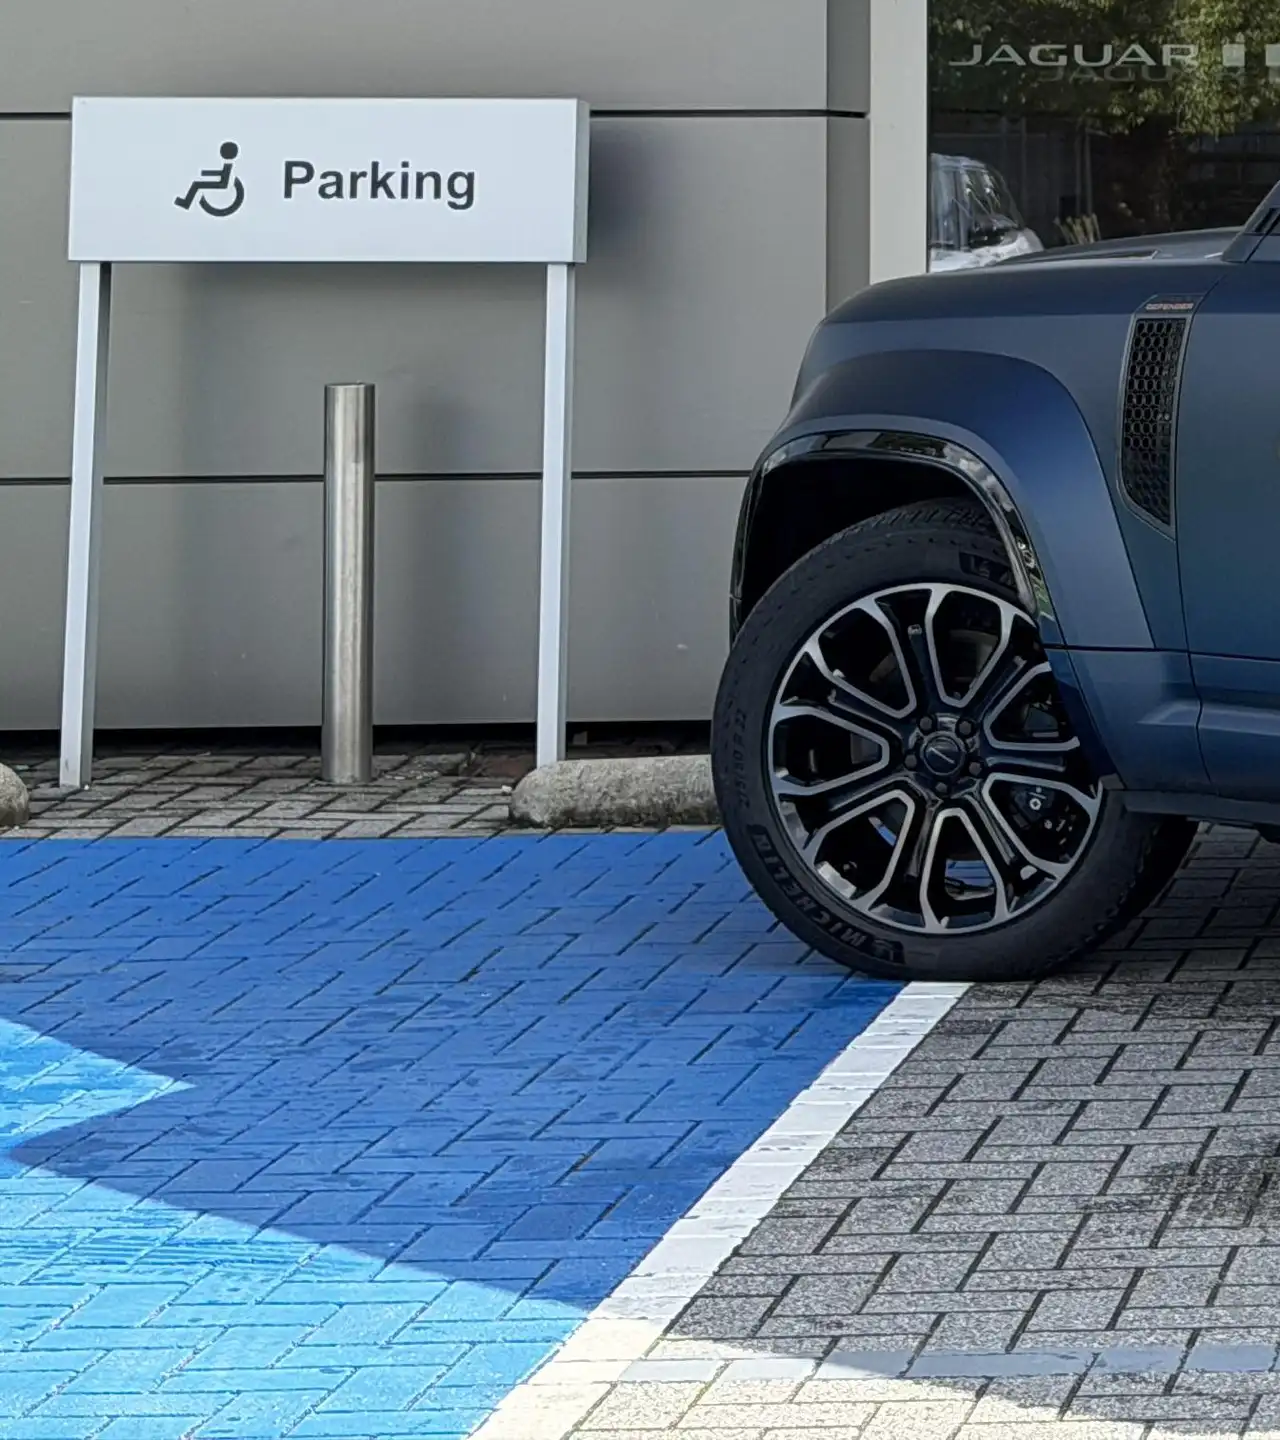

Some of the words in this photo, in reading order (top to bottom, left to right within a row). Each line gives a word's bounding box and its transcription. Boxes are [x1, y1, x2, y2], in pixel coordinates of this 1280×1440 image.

[948, 43, 1201, 67] JAGUAR
[283, 160, 476, 211] Parking
[752, 833, 868, 948] MICHELIN
